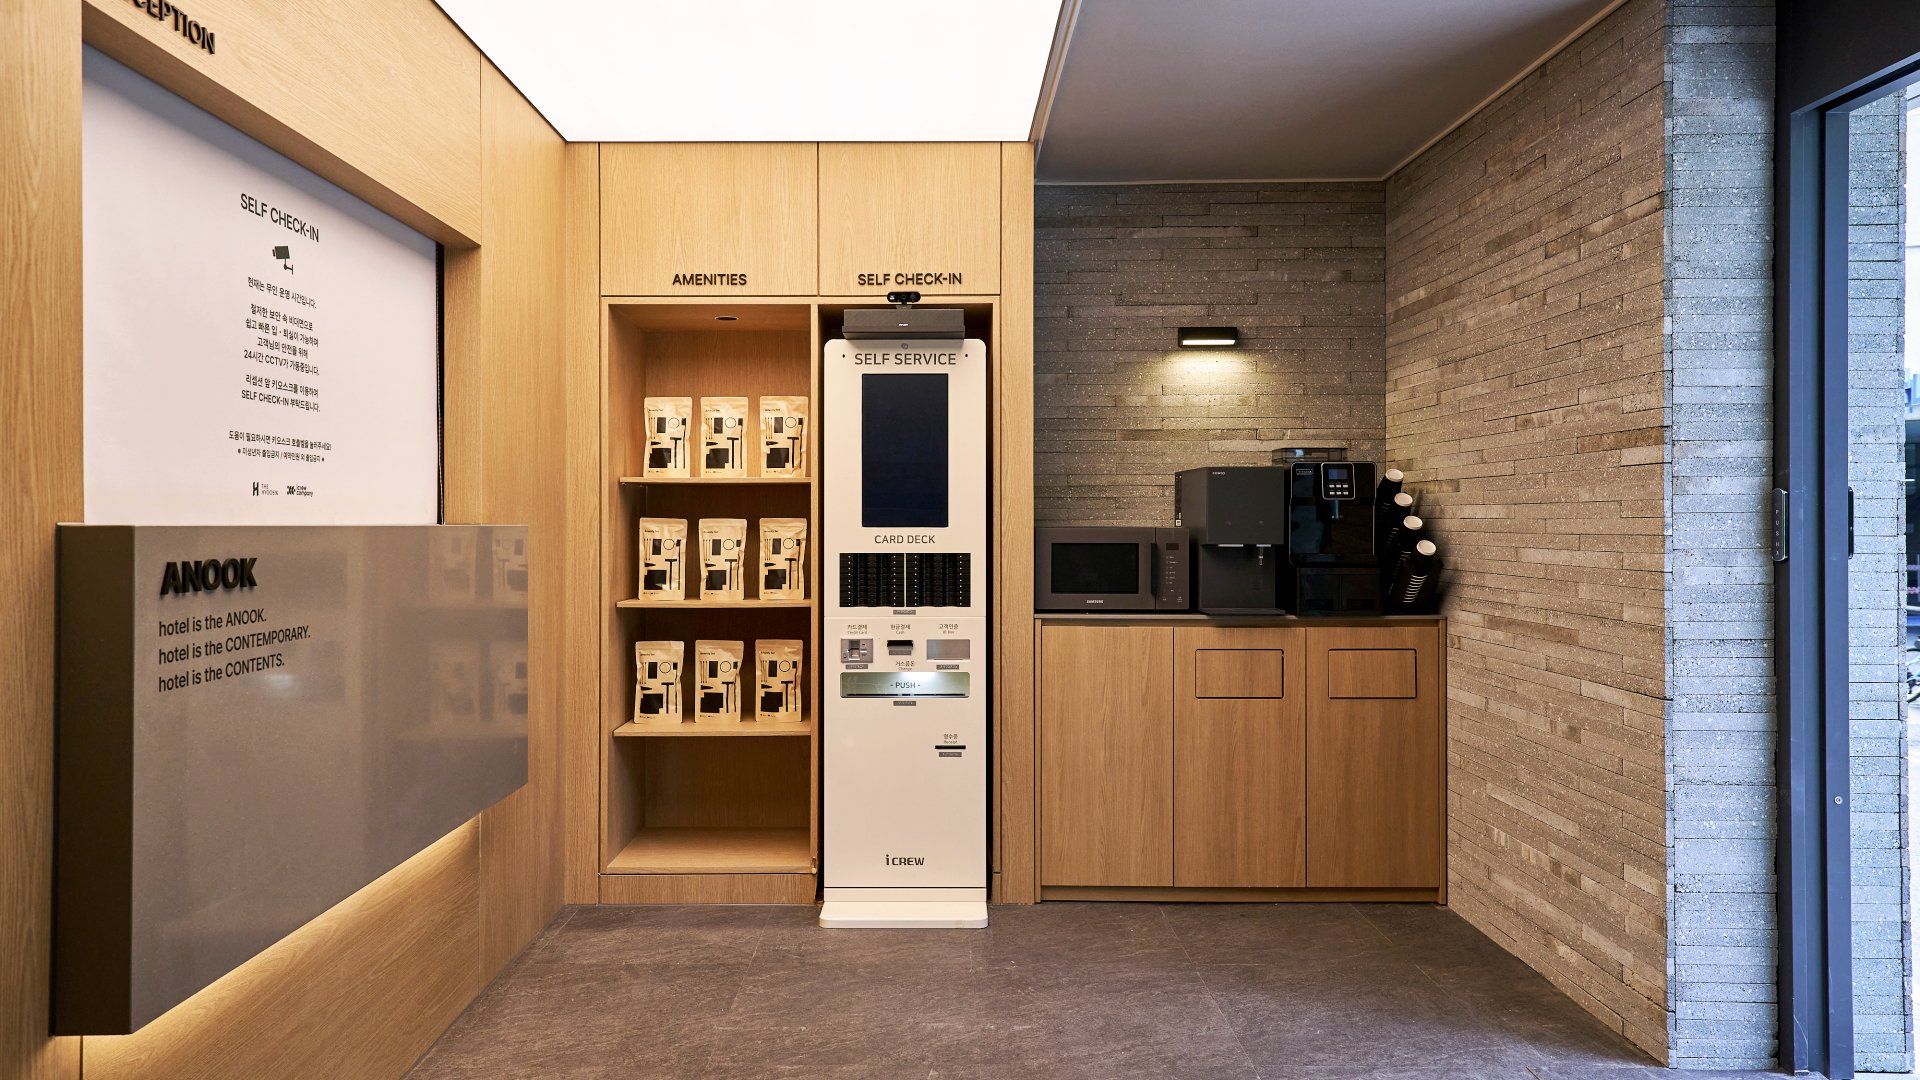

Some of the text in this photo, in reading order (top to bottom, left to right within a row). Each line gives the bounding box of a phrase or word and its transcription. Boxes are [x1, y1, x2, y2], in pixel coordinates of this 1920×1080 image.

[240, 193, 319, 242] SELF CHECK-IN
[672, 274, 747, 286] AMENITIES
[858, 272, 962, 286] SELF CHECK-IN
[248, 276, 316, 308] 현재는 무인 운영 시간입니다.
[246, 318, 257, 329] 쉽고
[272, 325, 277, 336] 입
[251, 304, 268, 318] 철저한
[269, 310, 281, 321] 보안
[289, 316, 313, 331] 비대면으로
[257, 337, 280, 351] 고객님의
[244, 349, 320, 375] 24시간 CCTV가 가동중입니다.
[854, 353, 956, 365] SELF SERVICE
[246, 374, 263, 387] 리셉션
[272, 380, 298, 394] 키오스크를
[242, 390, 320, 412] SELF CHECK-IN 부탁드립니다.
[874, 535, 935, 544] CARD DECK
[160, 558, 258, 596] ANOOK
[159, 608, 267, 637] hotel is the ANOOK.
[159, 625, 311, 665] hotel is the CONTEMPORARY.
[158, 653, 284, 692] hotel is the CONTENTS.
